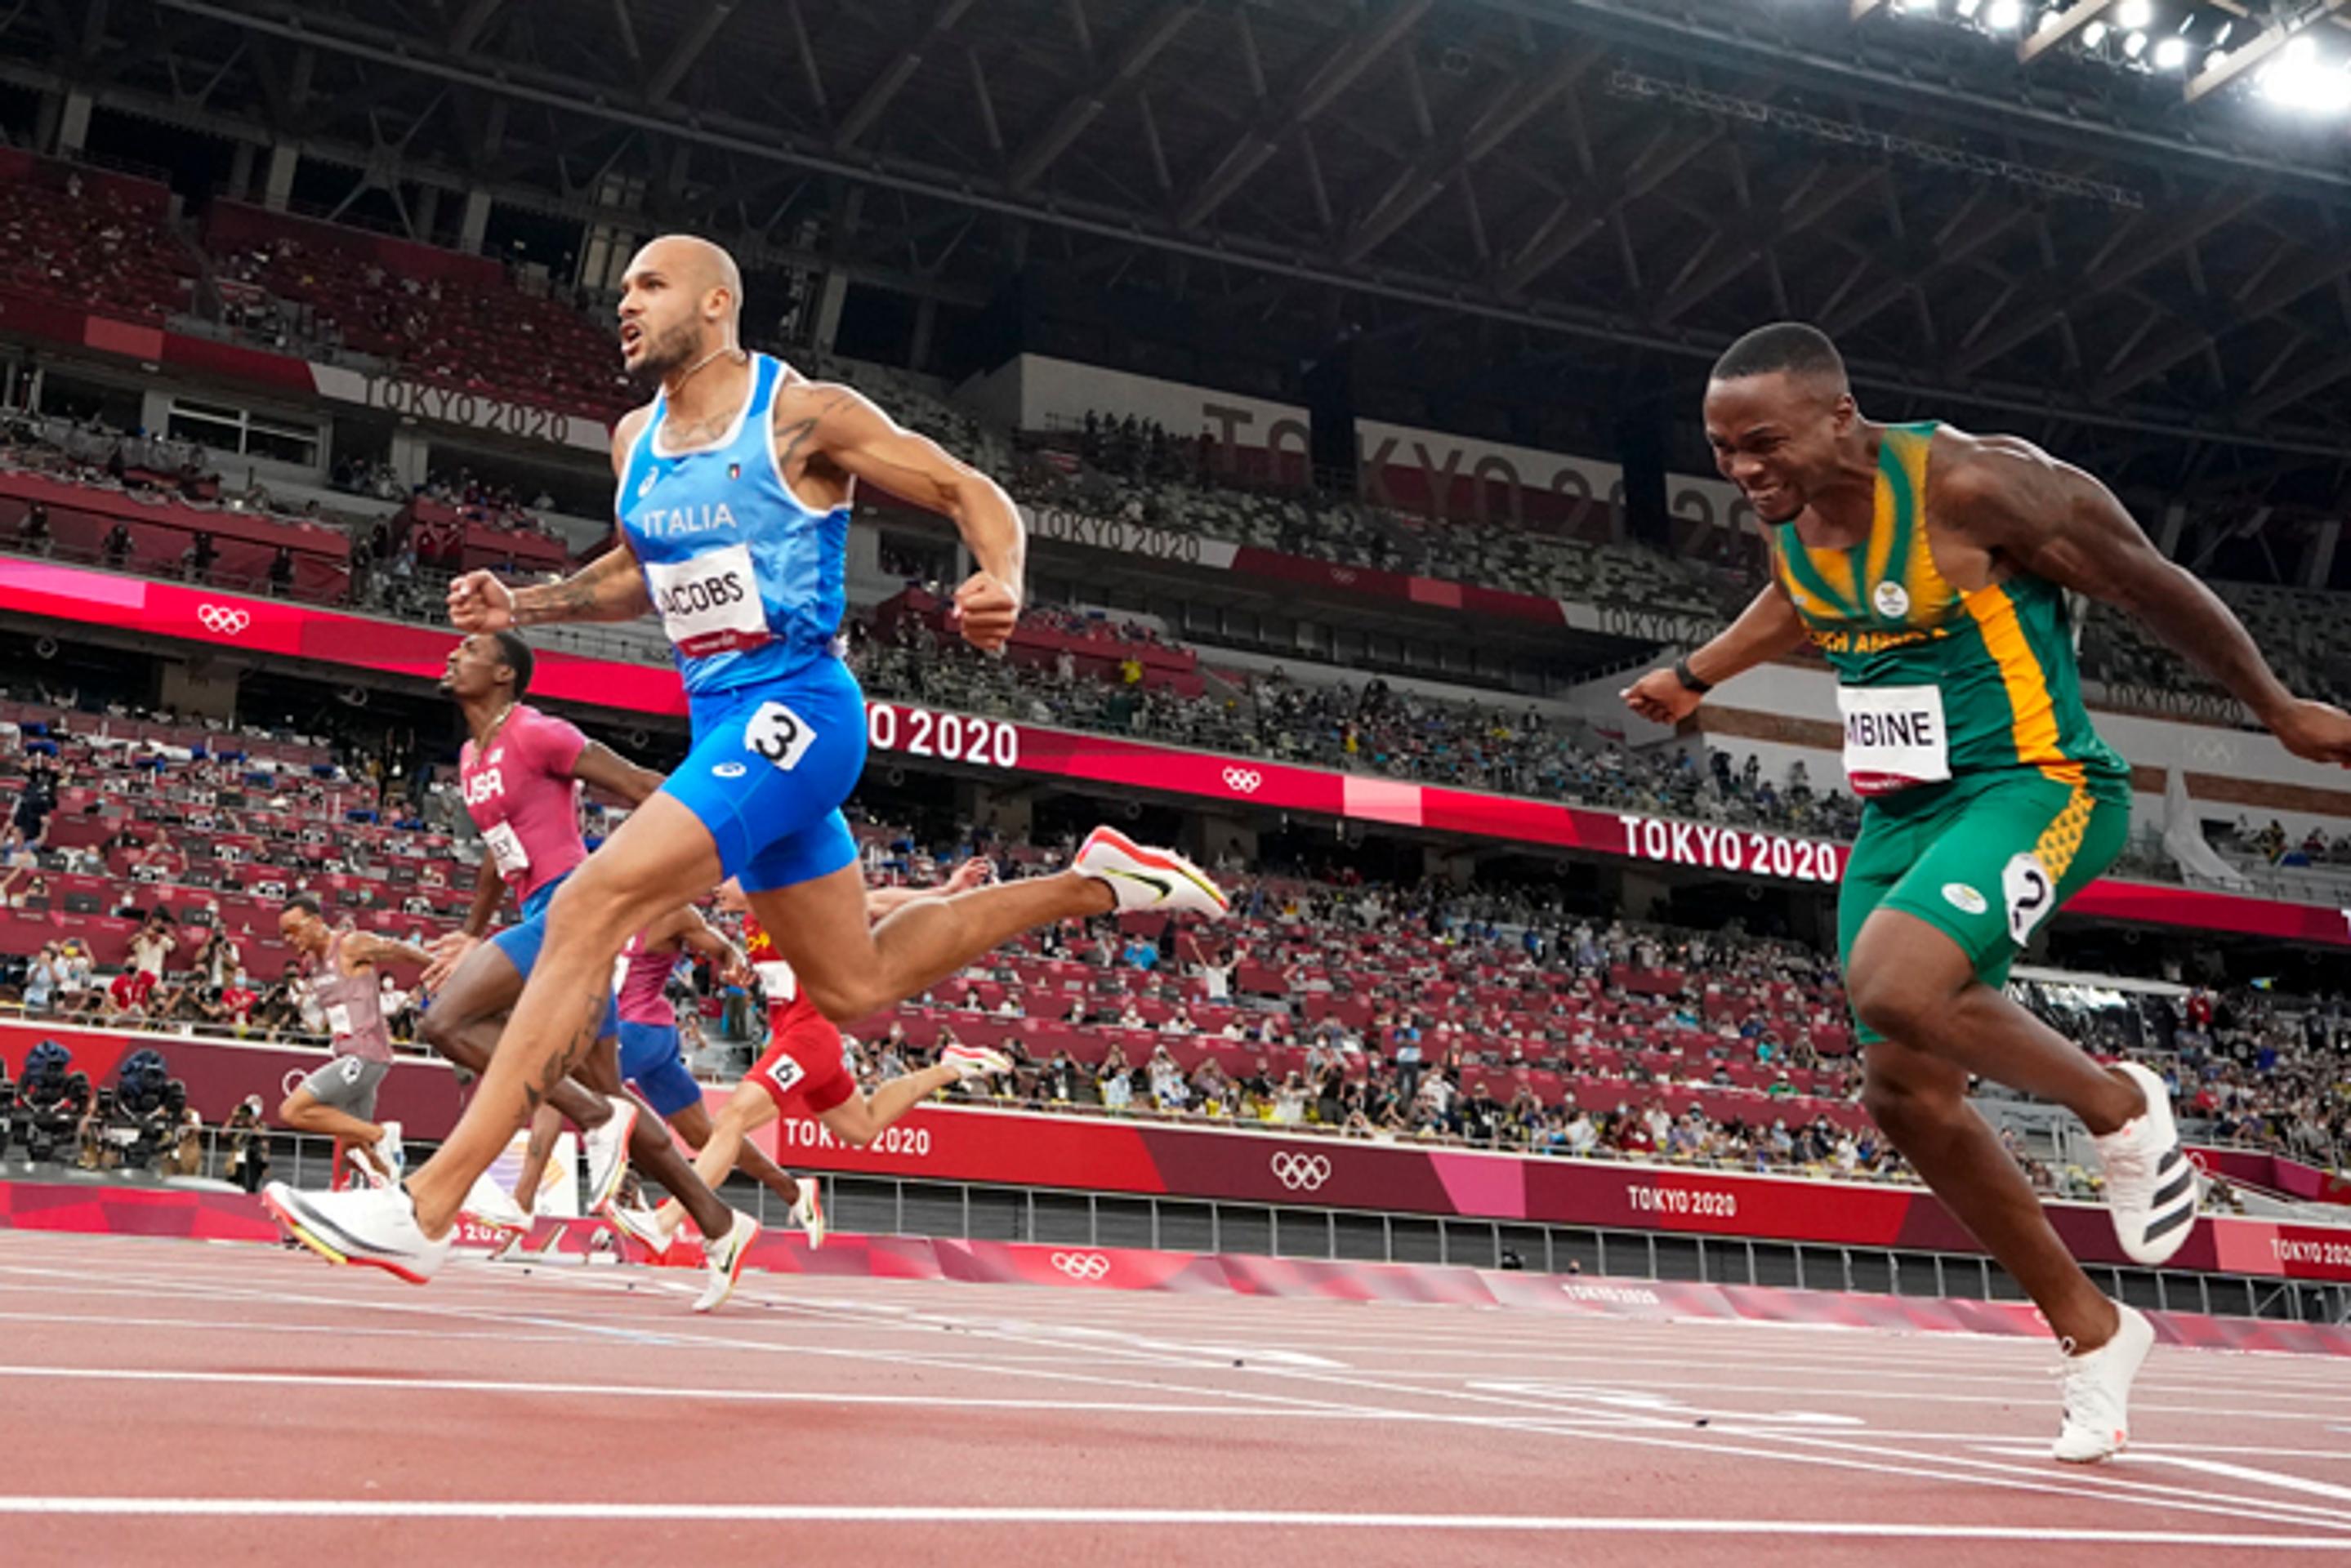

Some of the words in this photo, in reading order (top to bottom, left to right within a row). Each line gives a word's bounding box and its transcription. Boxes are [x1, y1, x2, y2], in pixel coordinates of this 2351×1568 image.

[363, 374, 476, 425] TOKYO
[486, 399, 569, 444] 2020
[642, 502, 737, 538] ITALIA
[1032, 508, 1123, 550] TOKYO
[1131, 524, 1200, 562] 2020
[1595, 604, 1675, 643] TOKYO
[756, 713, 797, 763] 3
[908, 709, 1018, 768] 2020
[463, 768, 505, 806] USA
[1619, 815, 1741, 871] TOKYO
[1749, 833, 1836, 883] 2020
[775, 1062, 794, 1083] 6
[870, 1126, 931, 1156] 2020
[1627, 1185, 1689, 1214] TOKYO
[1692, 1191, 1737, 1217] 2020
[2270, 1238, 2322, 1264] TOKYO
